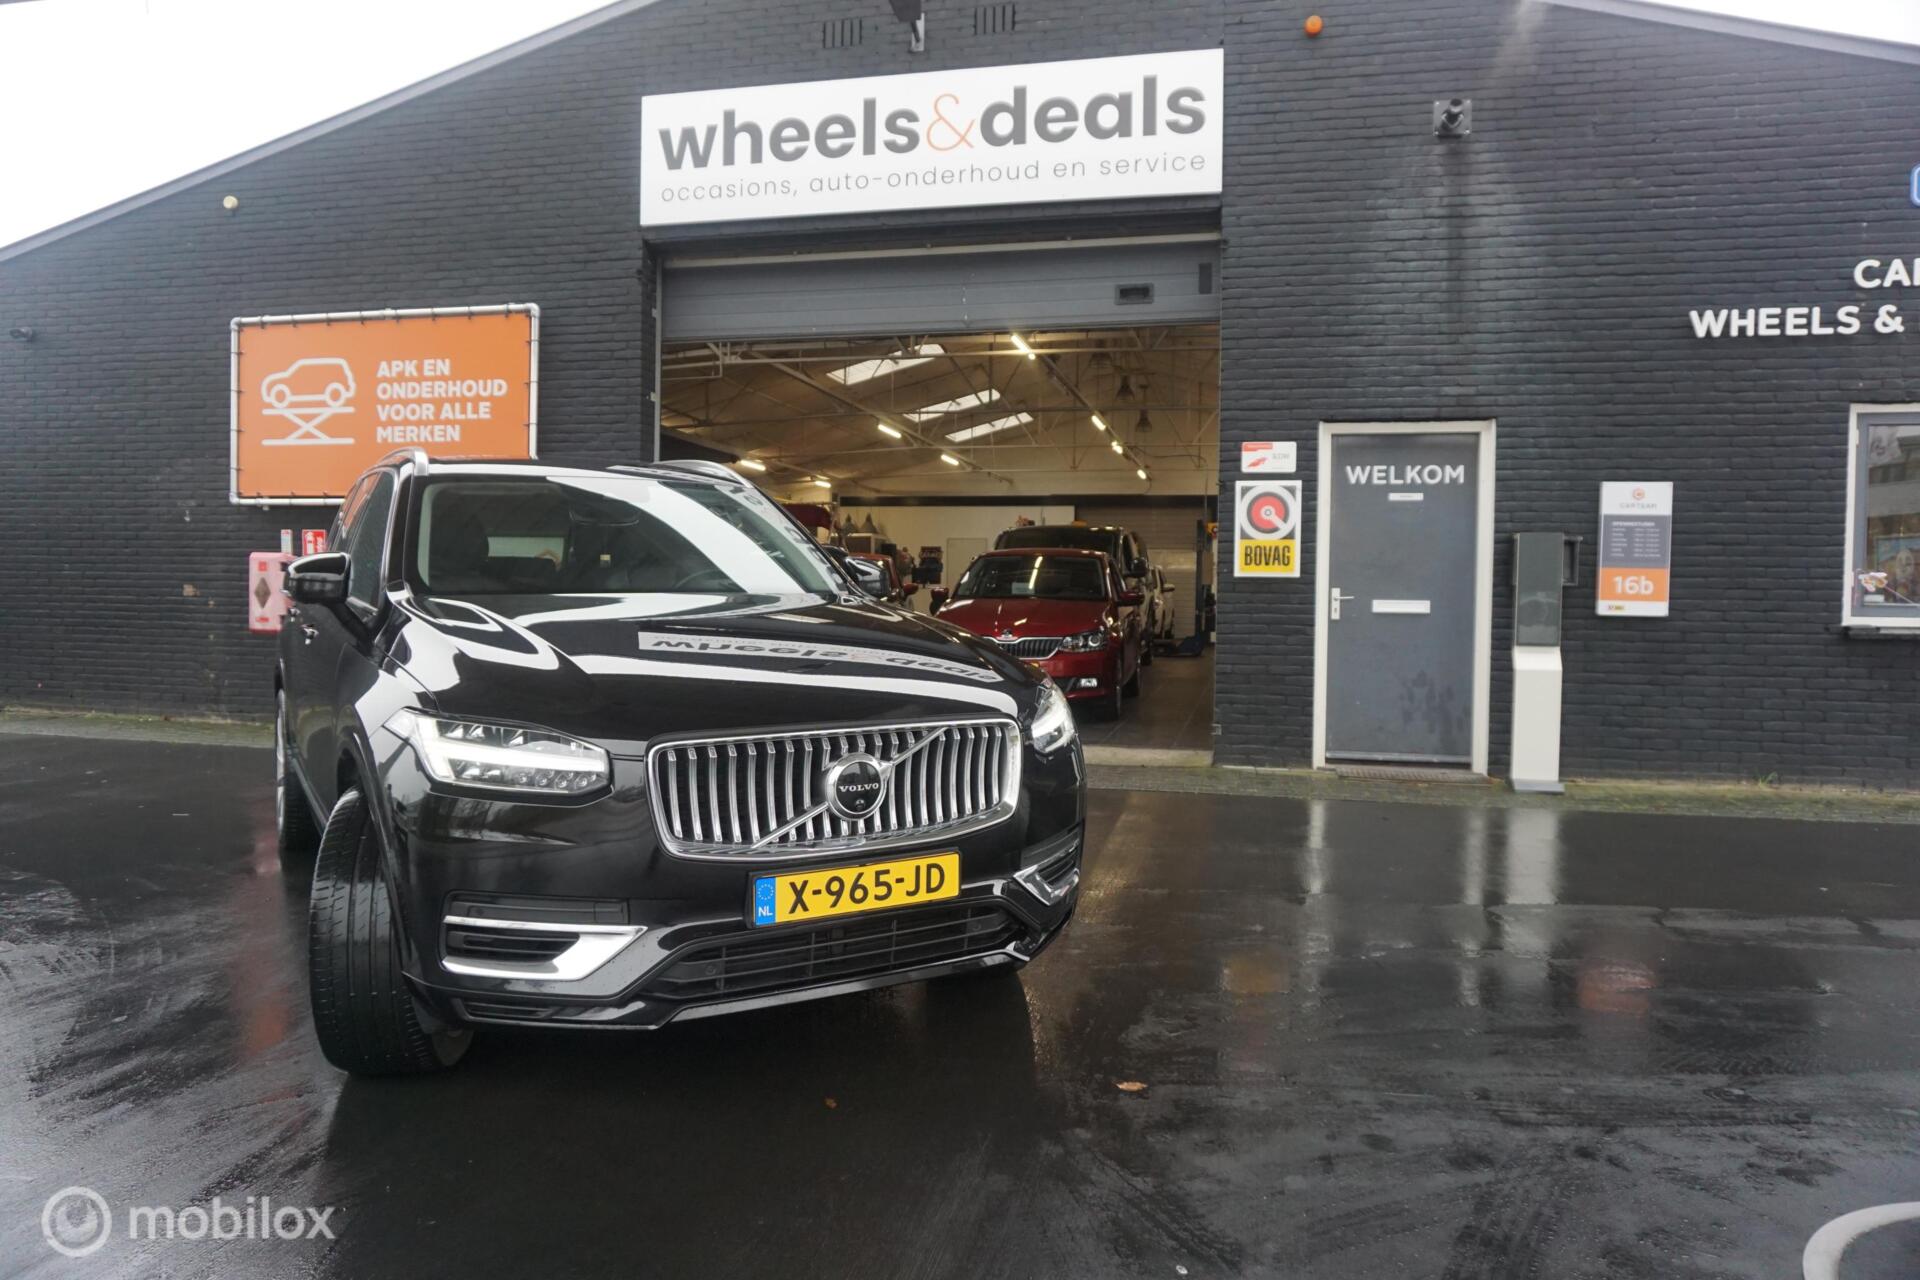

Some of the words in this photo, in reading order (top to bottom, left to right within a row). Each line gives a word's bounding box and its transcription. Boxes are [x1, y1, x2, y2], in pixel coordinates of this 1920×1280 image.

[658, 75, 1206, 171] wheels&deals
[661, 178, 798, 202] occasions,
[810, 161, 1039, 193] auto-onderhoud
[1053, 161, 1086, 178] en
[1099, 152, 1206, 176] service
[1689, 305, 1861, 338] WHEELS
[1874, 304, 1905, 334] &
[376, 360, 418, 378] APK
[423, 358, 450, 376] EN
[376, 379, 508, 400] ONDERHOUD
[376, 403, 435, 421] VOOR
[439, 401, 491, 419] ALLE
[376, 424, 461, 443] MERKEN
[1345, 464, 1465, 485] WELKOM
[1244, 545, 1291, 566] BOVAG
[1612, 576, 1654, 595] 16b
[838, 782, 879, 793] VOLVO
[758, 905, 774, 917] NL
[788, 862, 946, 914] X-965-JD
